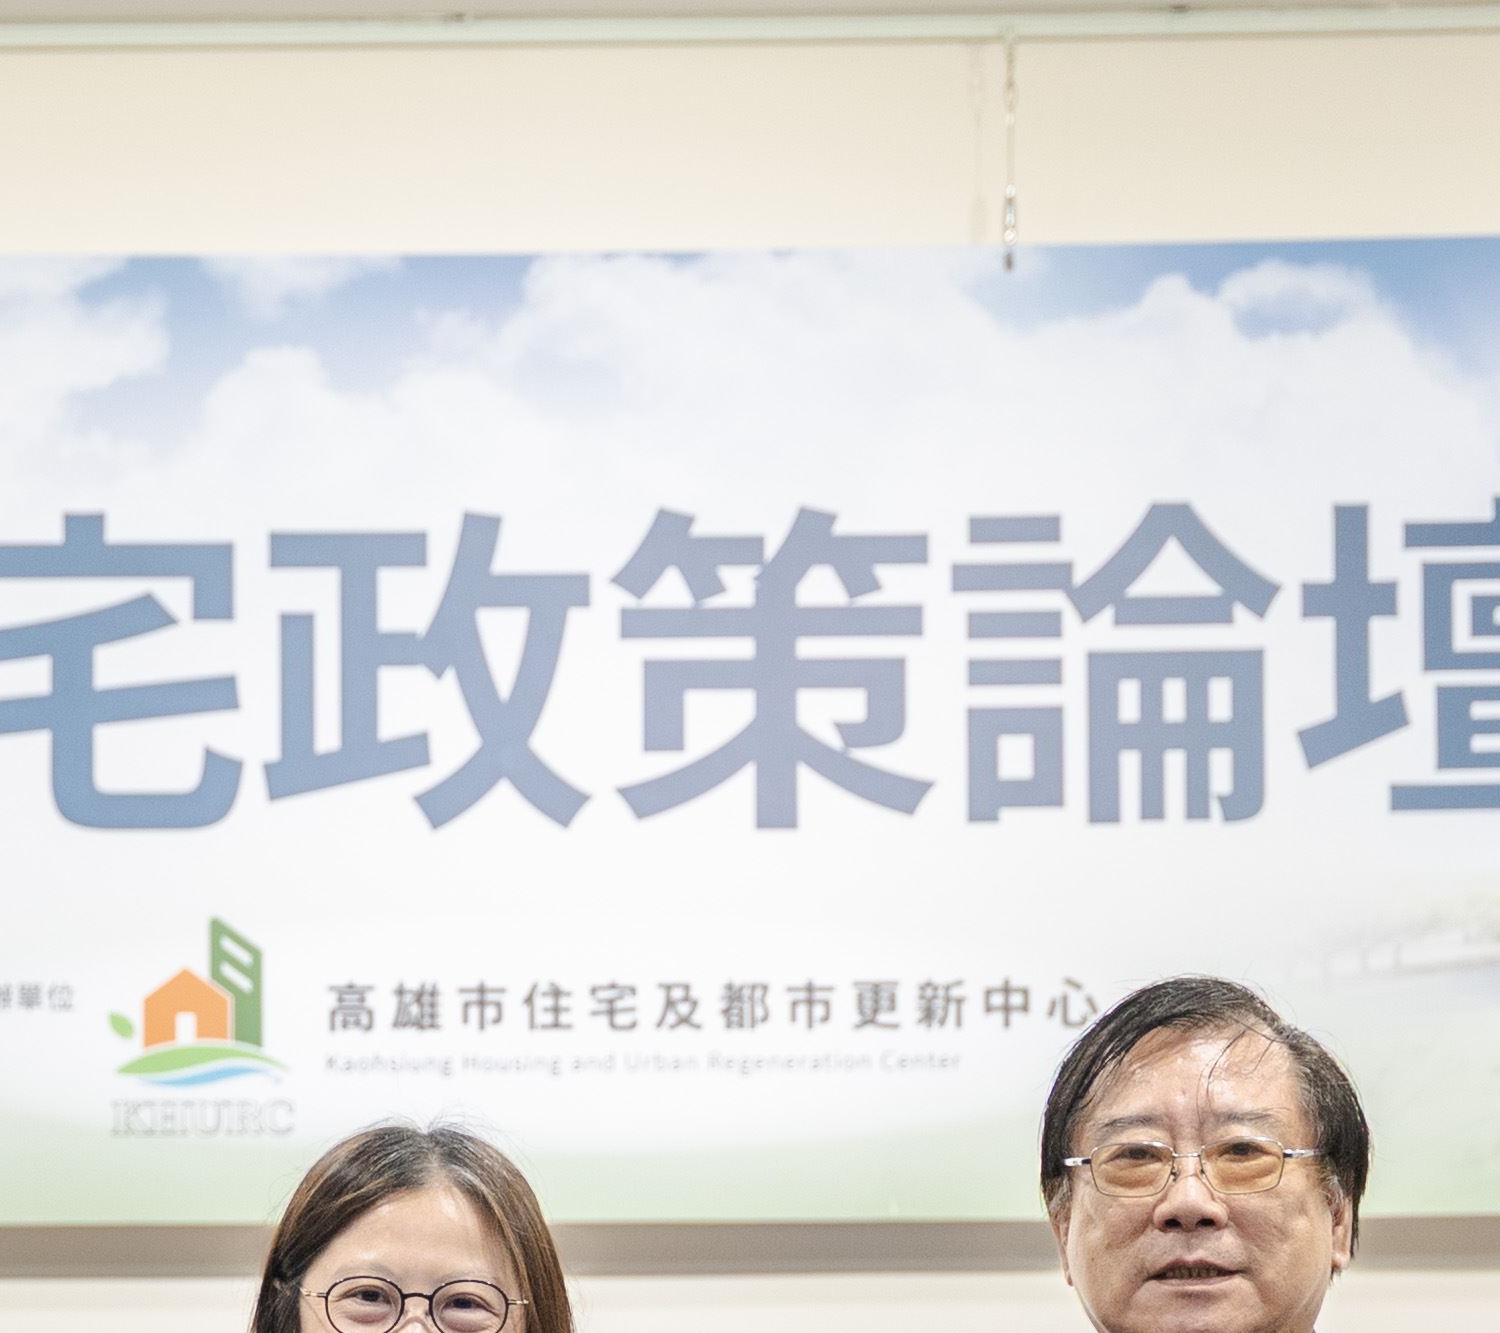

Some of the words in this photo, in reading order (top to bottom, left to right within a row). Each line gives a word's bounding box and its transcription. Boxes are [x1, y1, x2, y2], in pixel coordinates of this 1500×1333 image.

[328, 977, 1098, 1033] 高雄市住宅及都市更新中心
[325, 1051, 452, 1077] Kaohsiung
[461, 1051, 562, 1077] Housing
[571, 1052, 616, 1074] and
[623, 1052, 700, 1074] Urban
[707, 1049, 872, 1076] Regeneration
[880, 1049, 962, 1072] Center
[111, 1099, 296, 1138] KHURC
